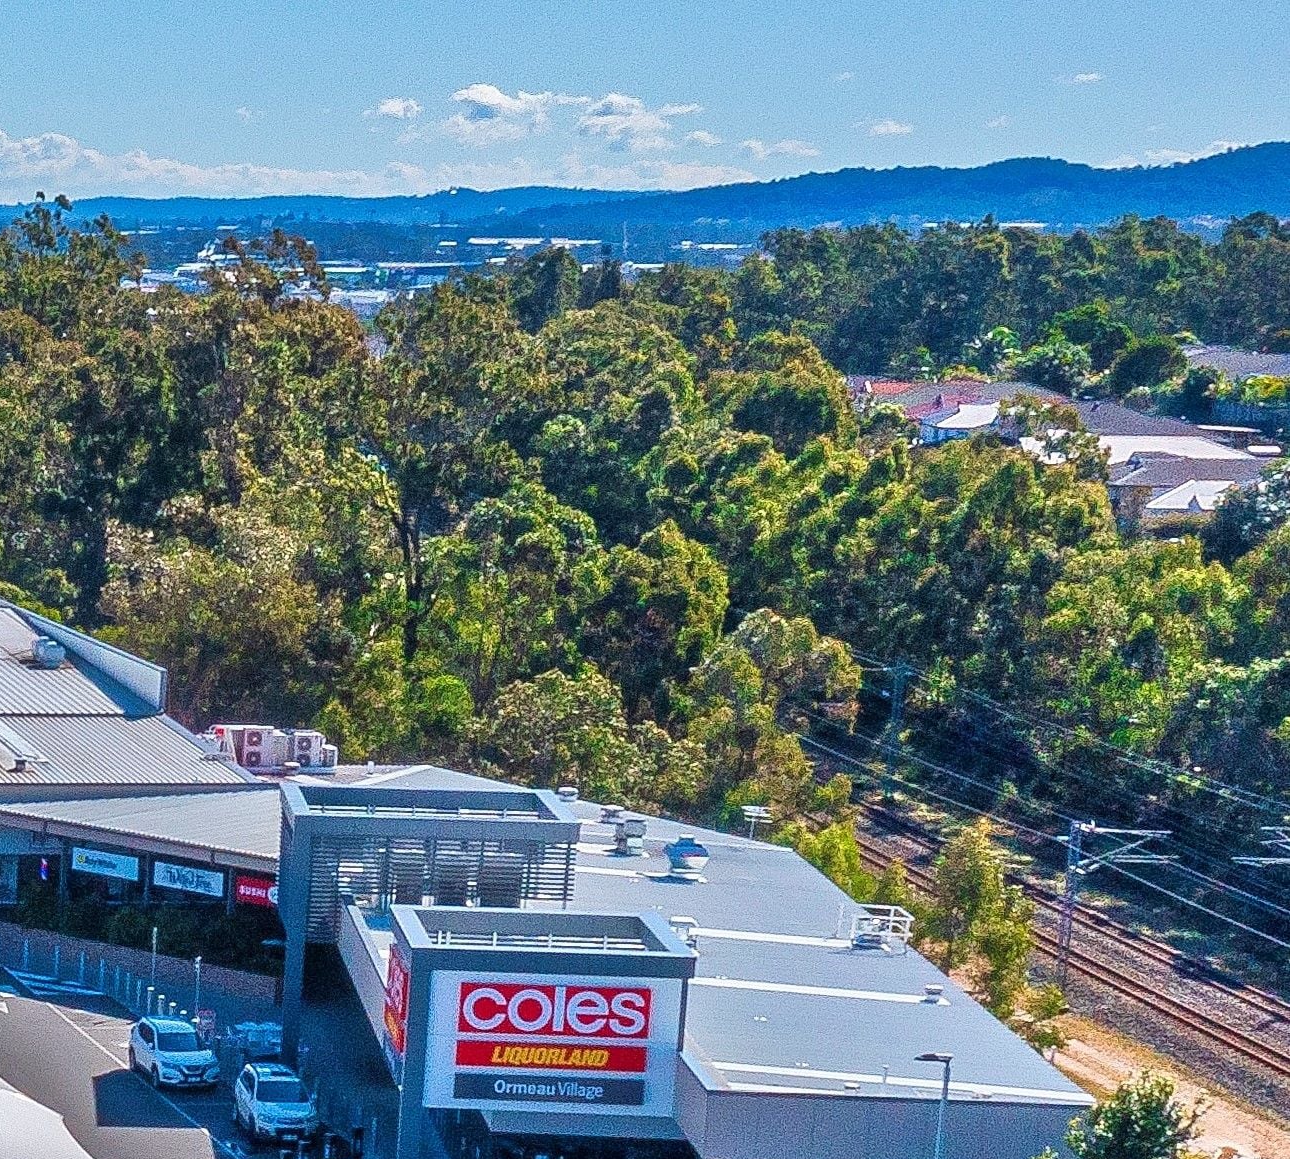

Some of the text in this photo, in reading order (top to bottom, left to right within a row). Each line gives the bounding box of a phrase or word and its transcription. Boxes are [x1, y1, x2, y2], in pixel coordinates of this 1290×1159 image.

[238, 884, 267, 898] SUSHI
[462, 985, 647, 1036] coles
[491, 1045, 610, 1068] LIQUORLAND
[493, 1079, 605, 1101] Ormeau Village
